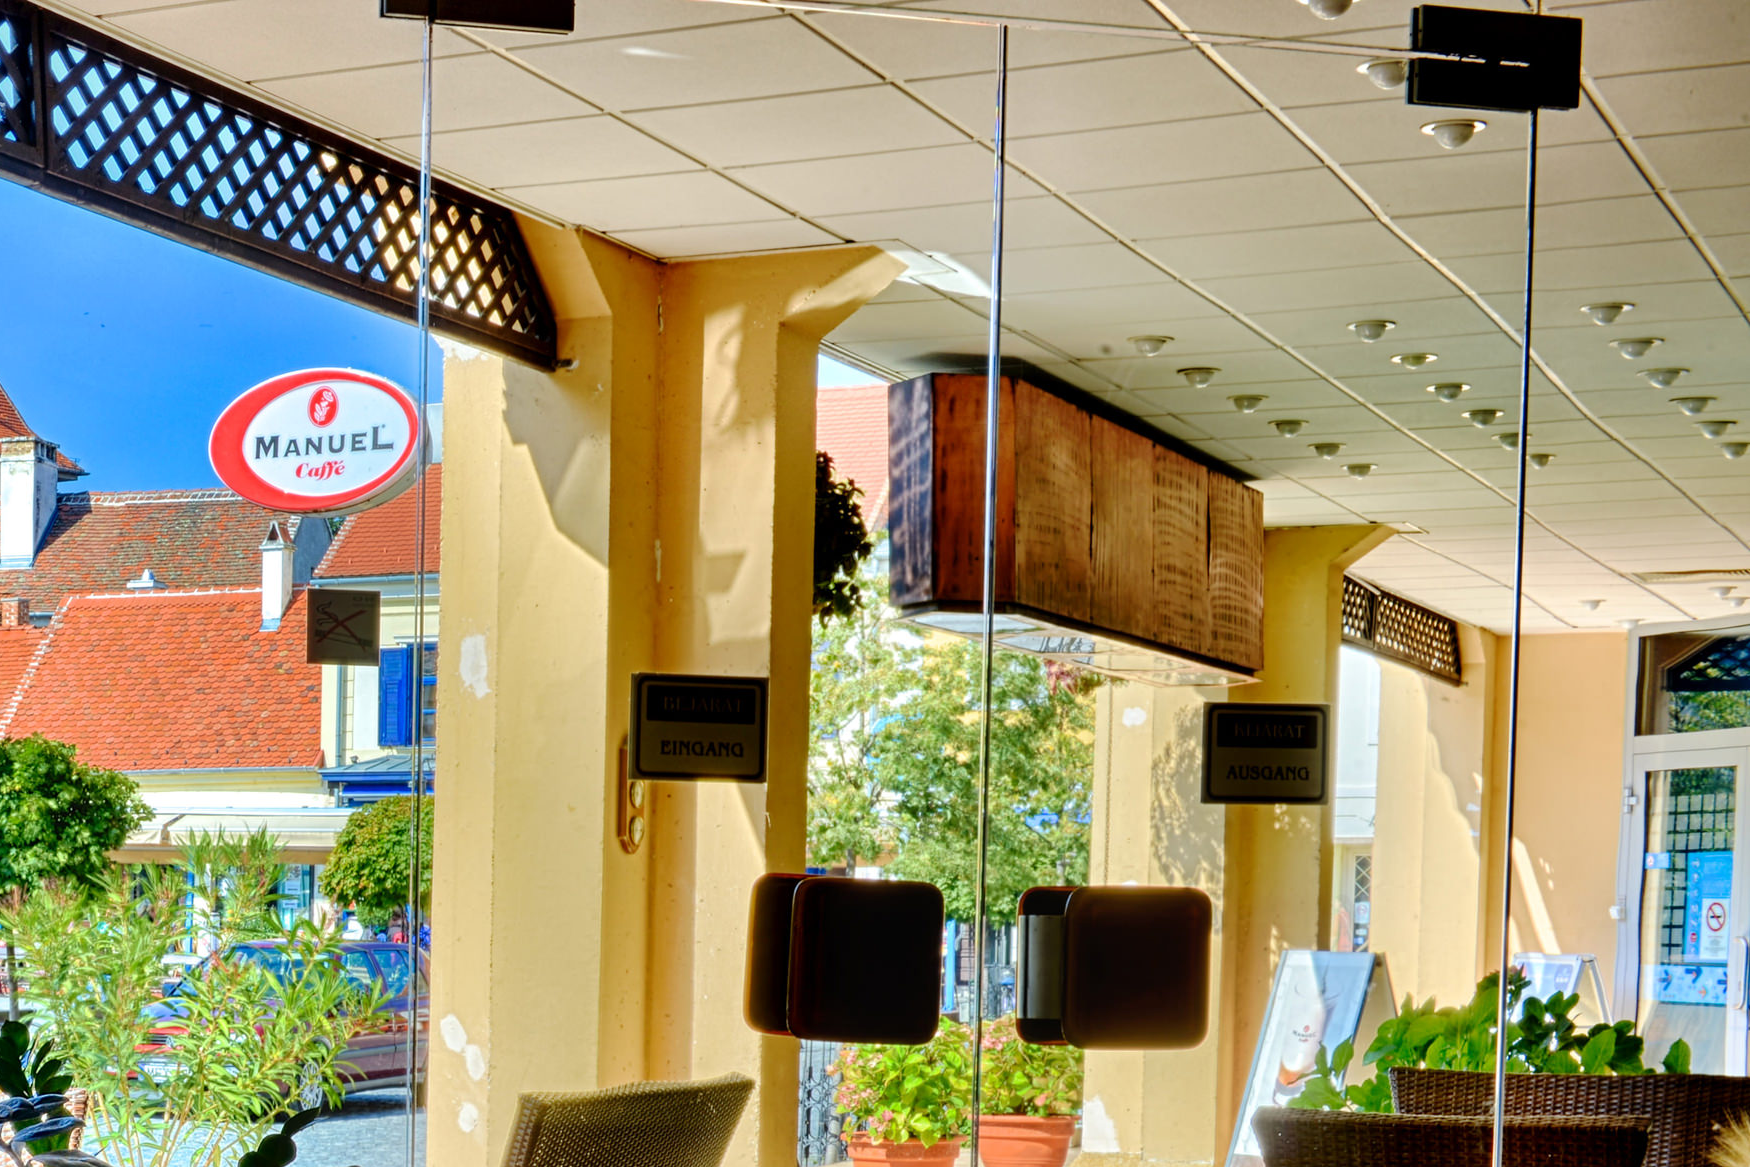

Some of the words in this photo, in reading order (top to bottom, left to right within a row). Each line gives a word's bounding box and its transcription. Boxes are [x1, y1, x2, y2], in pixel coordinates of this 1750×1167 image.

[255, 425, 394, 459] MANUEL
[660, 740, 744, 757] EINGANG
[1226, 764, 1310, 781] AUSGANG
